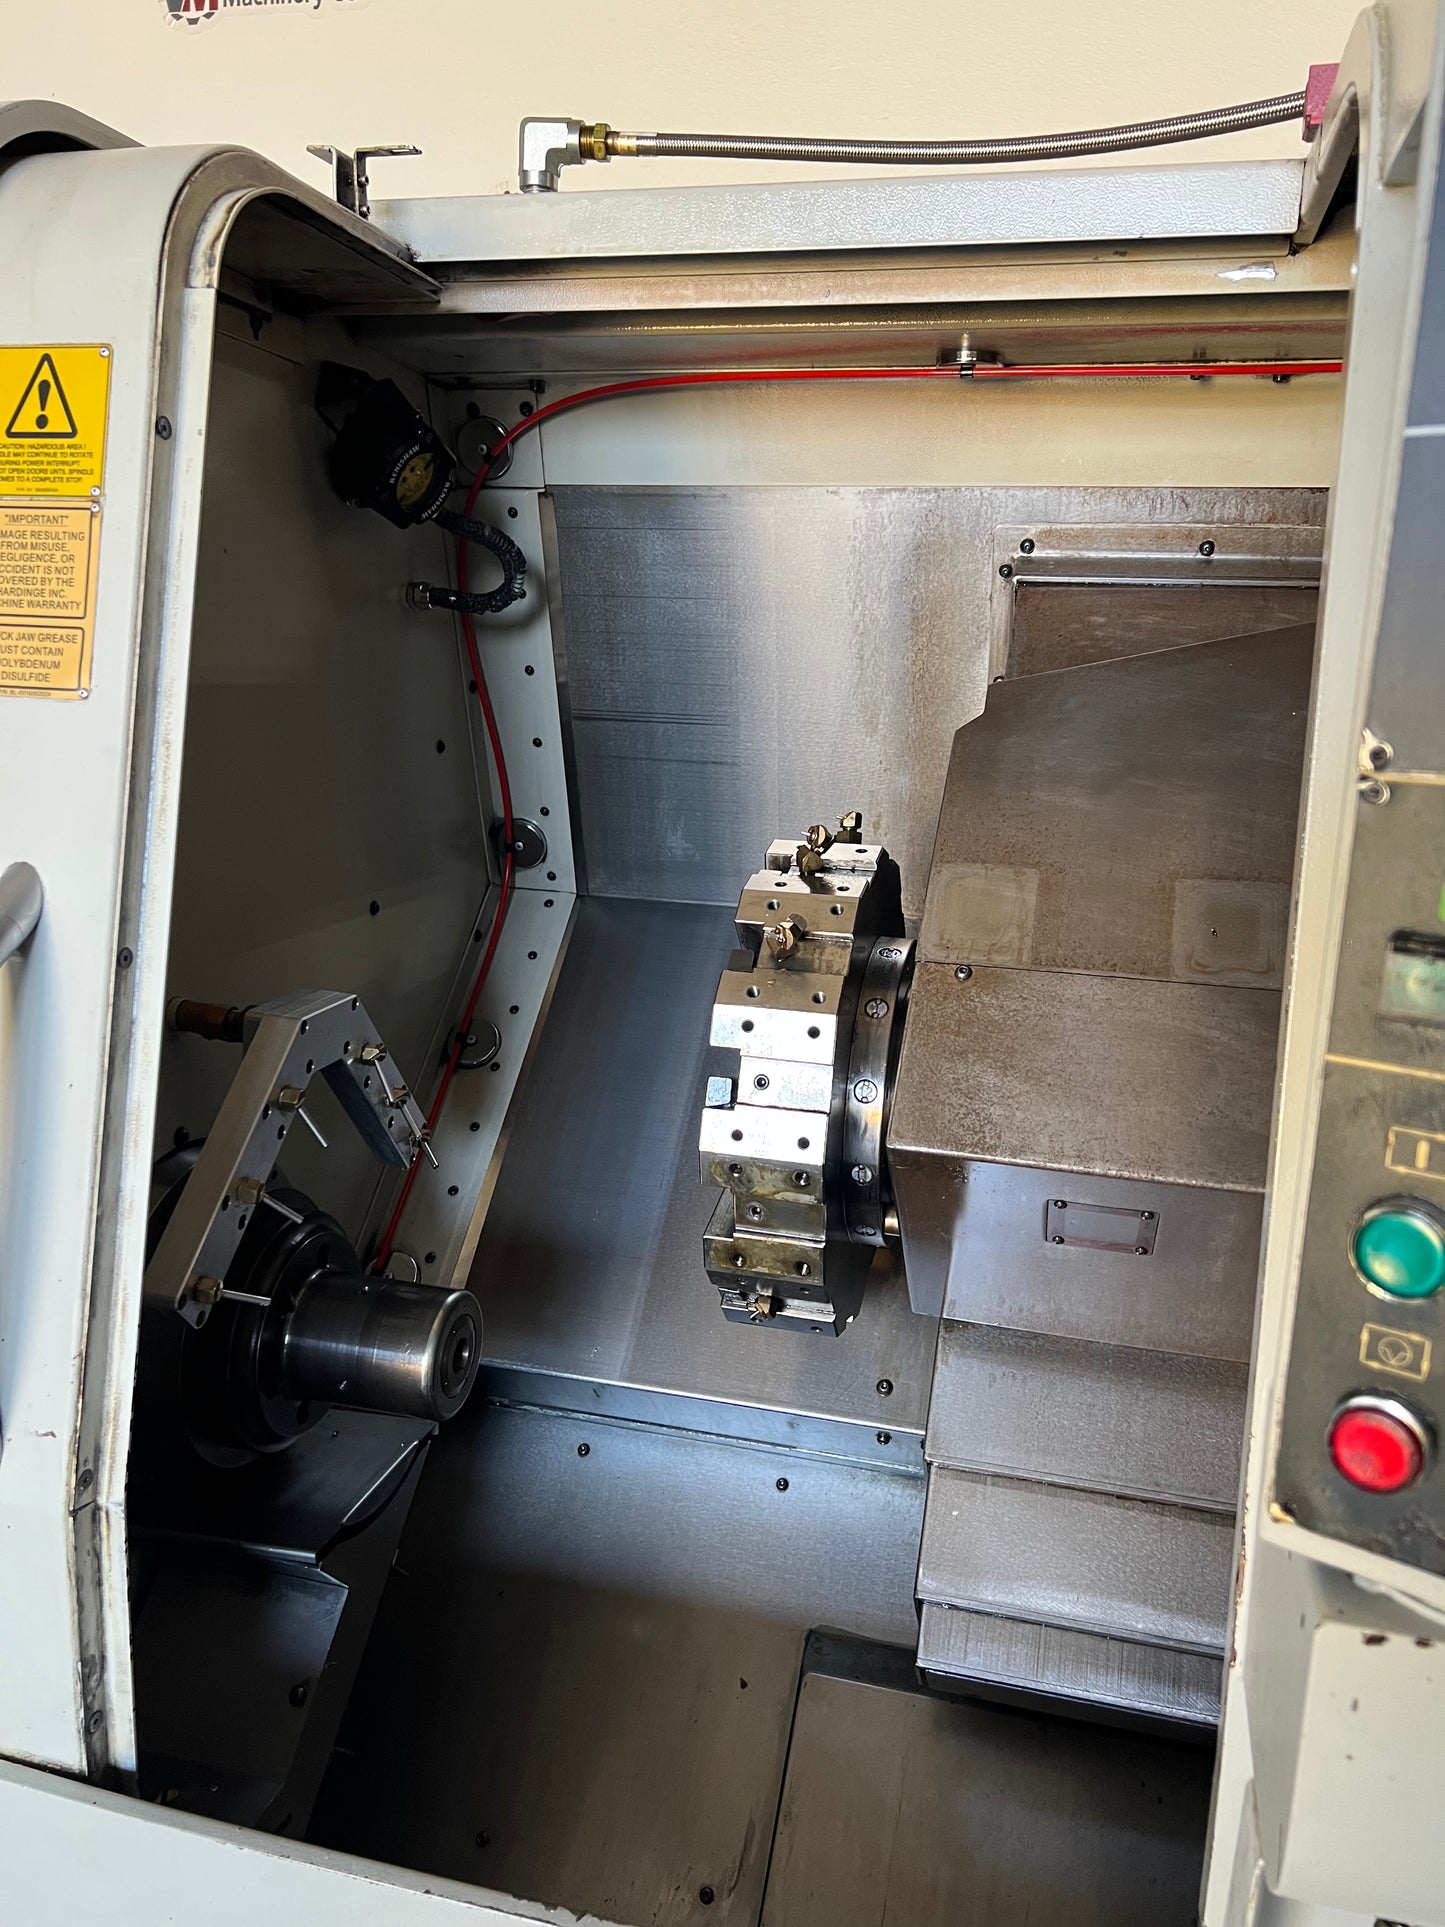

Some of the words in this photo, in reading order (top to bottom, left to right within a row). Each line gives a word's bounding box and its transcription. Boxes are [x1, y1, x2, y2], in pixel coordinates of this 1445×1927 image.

[389, 444, 420, 484] RENISHAW
[420, 482, 450, 520] RENISHAW
[5, 514, 69, 524] "IMPORTANT"
[30, 530, 86, 541] RESULTING
[0, 541, 28, 550] FROM
[30, 542, 70, 552] MISUSE,
[61, 554, 76, 564] OR
[43, 566, 52, 575] IS
[54, 566, 76, 576] NOT
[40, 576, 54, 586] BY
[56, 578, 75, 587] THE
[49, 589, 68, 598] INC.
[27, 600, 82, 610] WARRANTY
[16, 632, 36, 642] JAW
[38, 634, 78, 644] GREASE
[21, 646, 64, 656] CONTAIN
[1, 670, 50, 682] DISULFIDE
